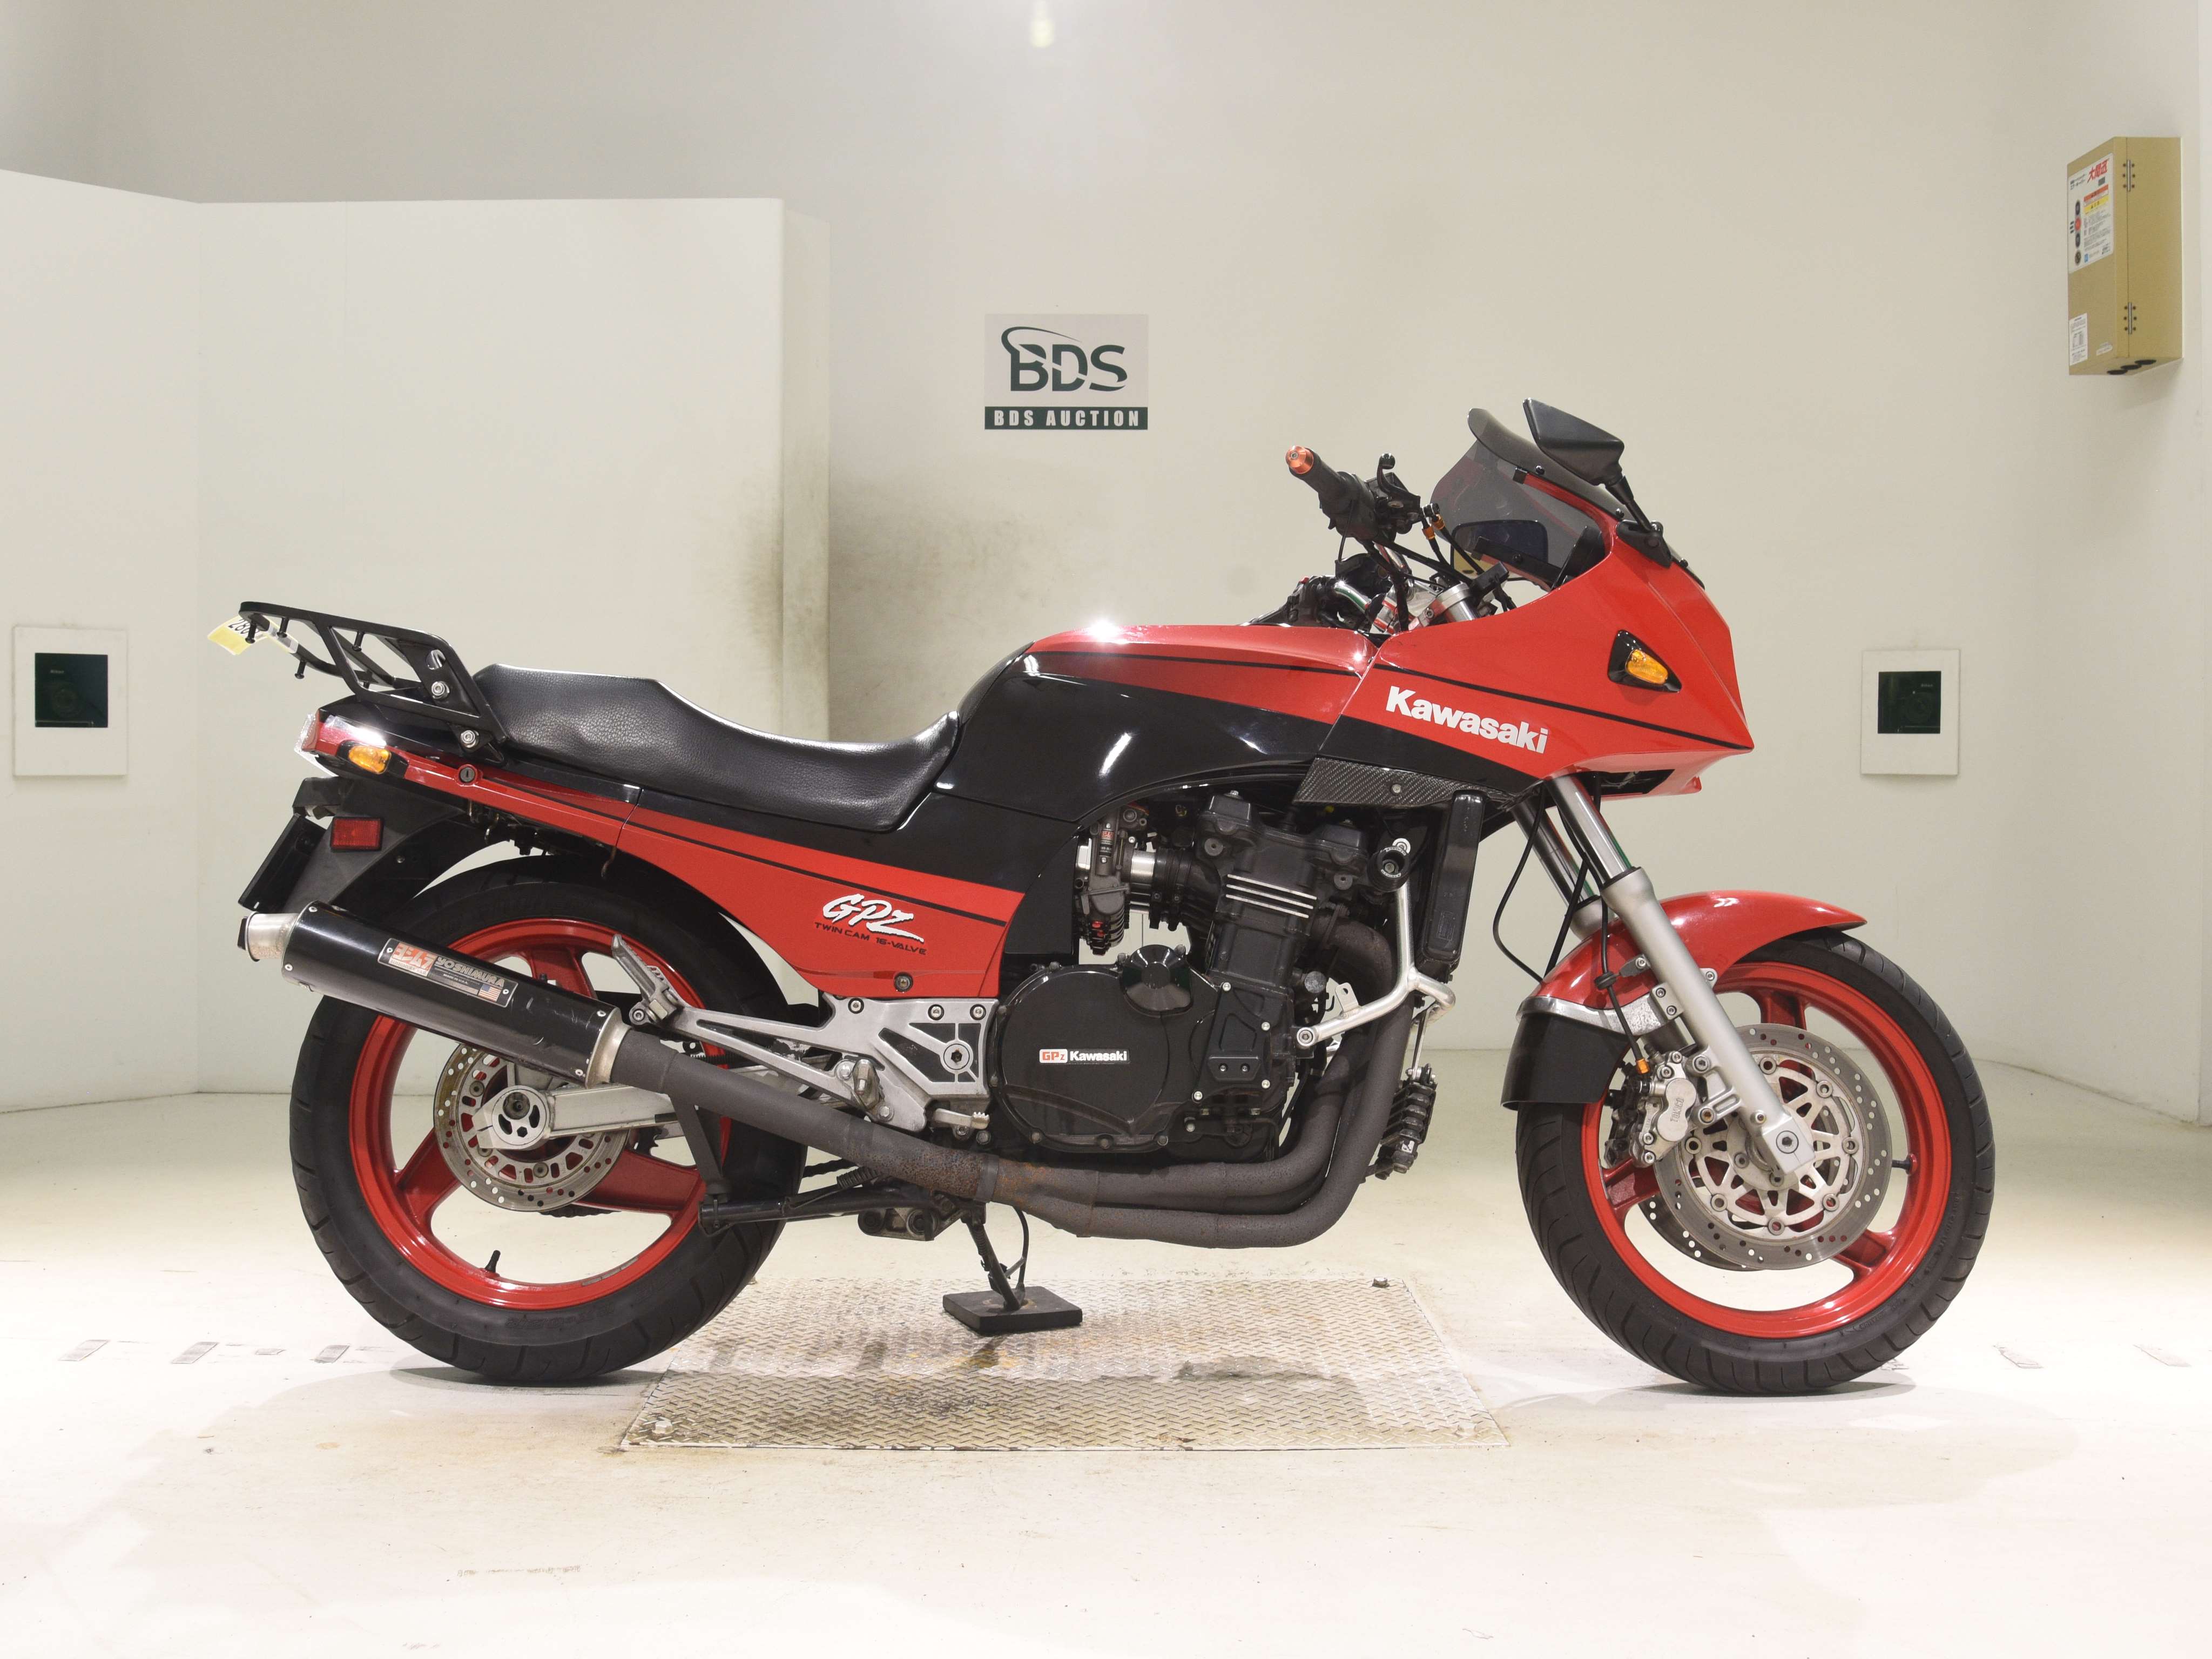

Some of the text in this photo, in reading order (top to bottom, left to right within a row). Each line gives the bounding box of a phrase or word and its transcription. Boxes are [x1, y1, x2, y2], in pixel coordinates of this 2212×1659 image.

[1001, 326, 1128, 391] BDS
[994, 410, 1138, 426] BDS AUCTION
[1386, 686, 1548, 753] Kawasaki
[814, 922, 927, 955] TWIN CAM 16-VALVE
[434, 956, 505, 987] YOSHIMURA
[1070, 1051, 1127, 1061] Kawasaki
